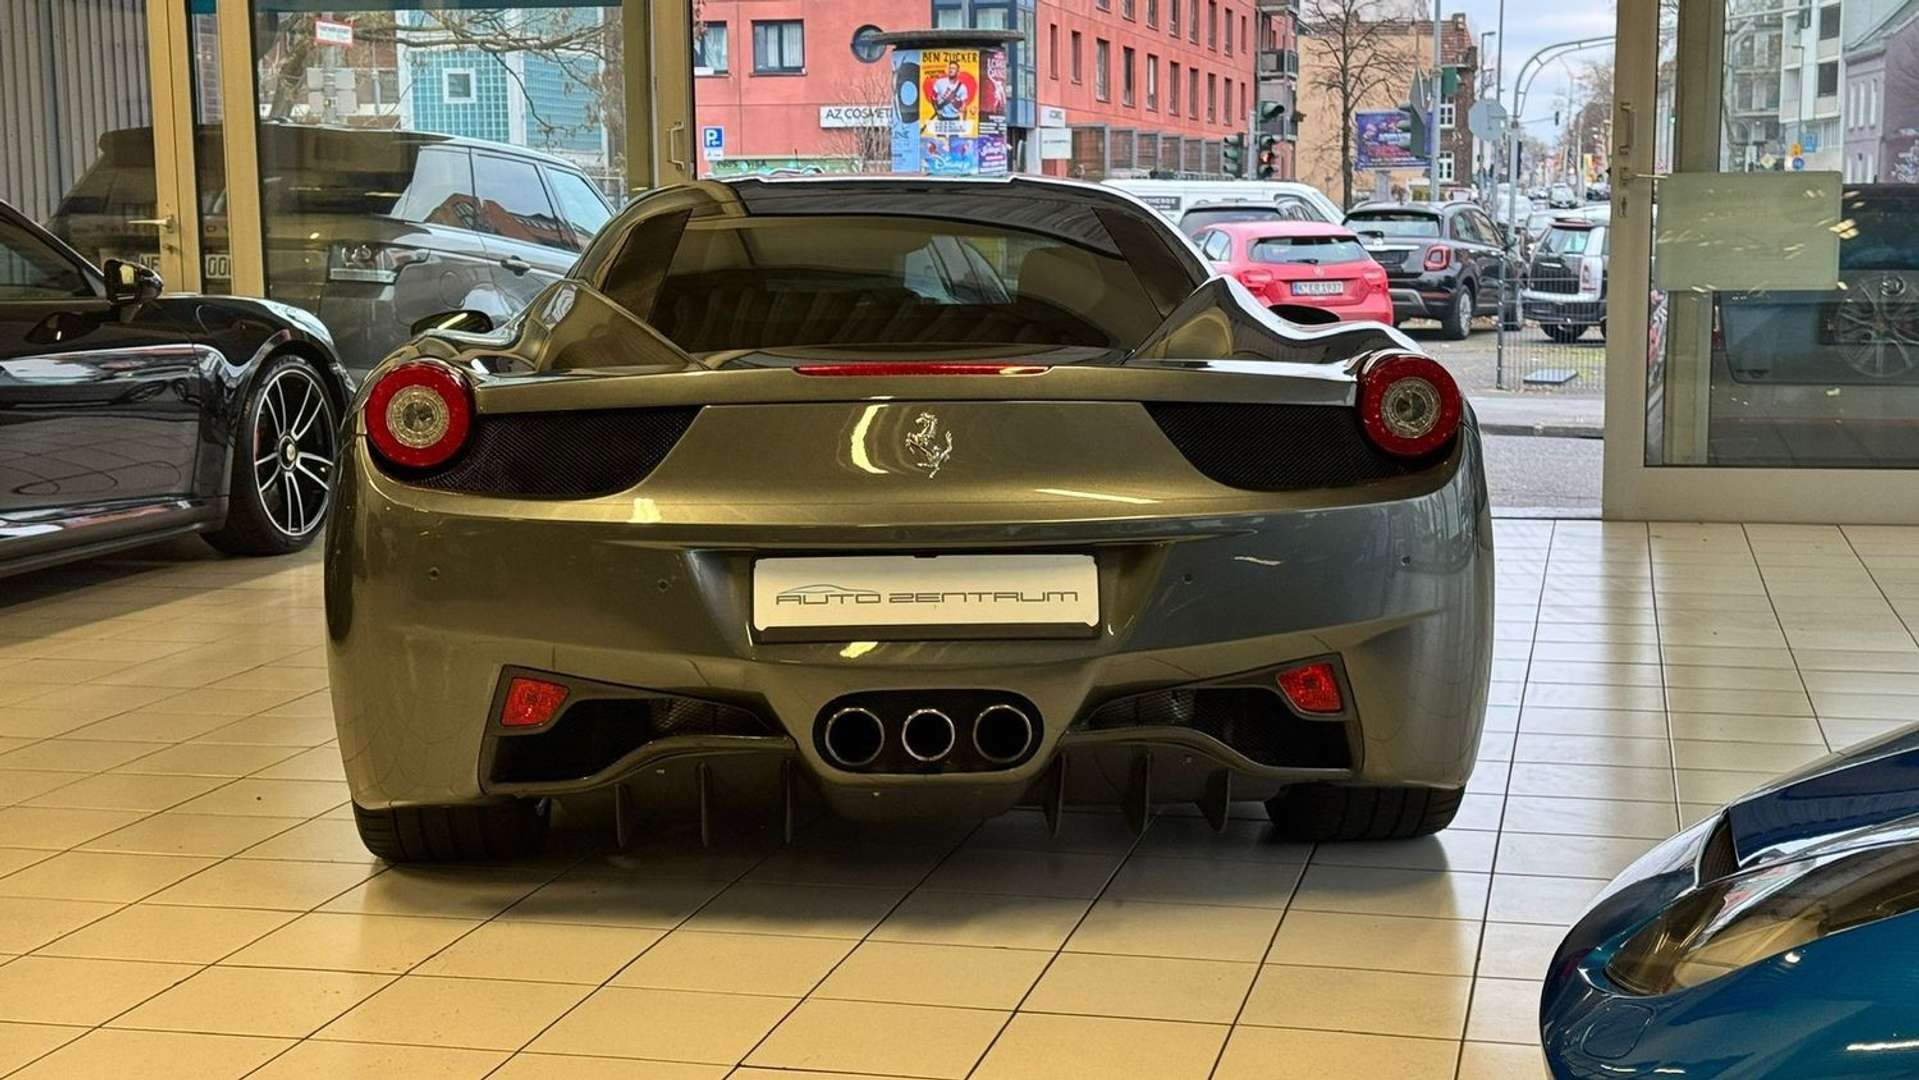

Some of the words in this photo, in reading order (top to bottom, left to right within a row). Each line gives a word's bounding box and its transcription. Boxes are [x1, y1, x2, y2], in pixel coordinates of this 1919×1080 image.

[922, 52, 940, 62] BEN
[943, 51, 978, 63] ZUCKER
[826, 108, 842, 120] AZ
[706, 129, 718, 147] P
[776, 592, 881, 606] AUTO
[888, 591, 1079, 604] ZENTRUM
